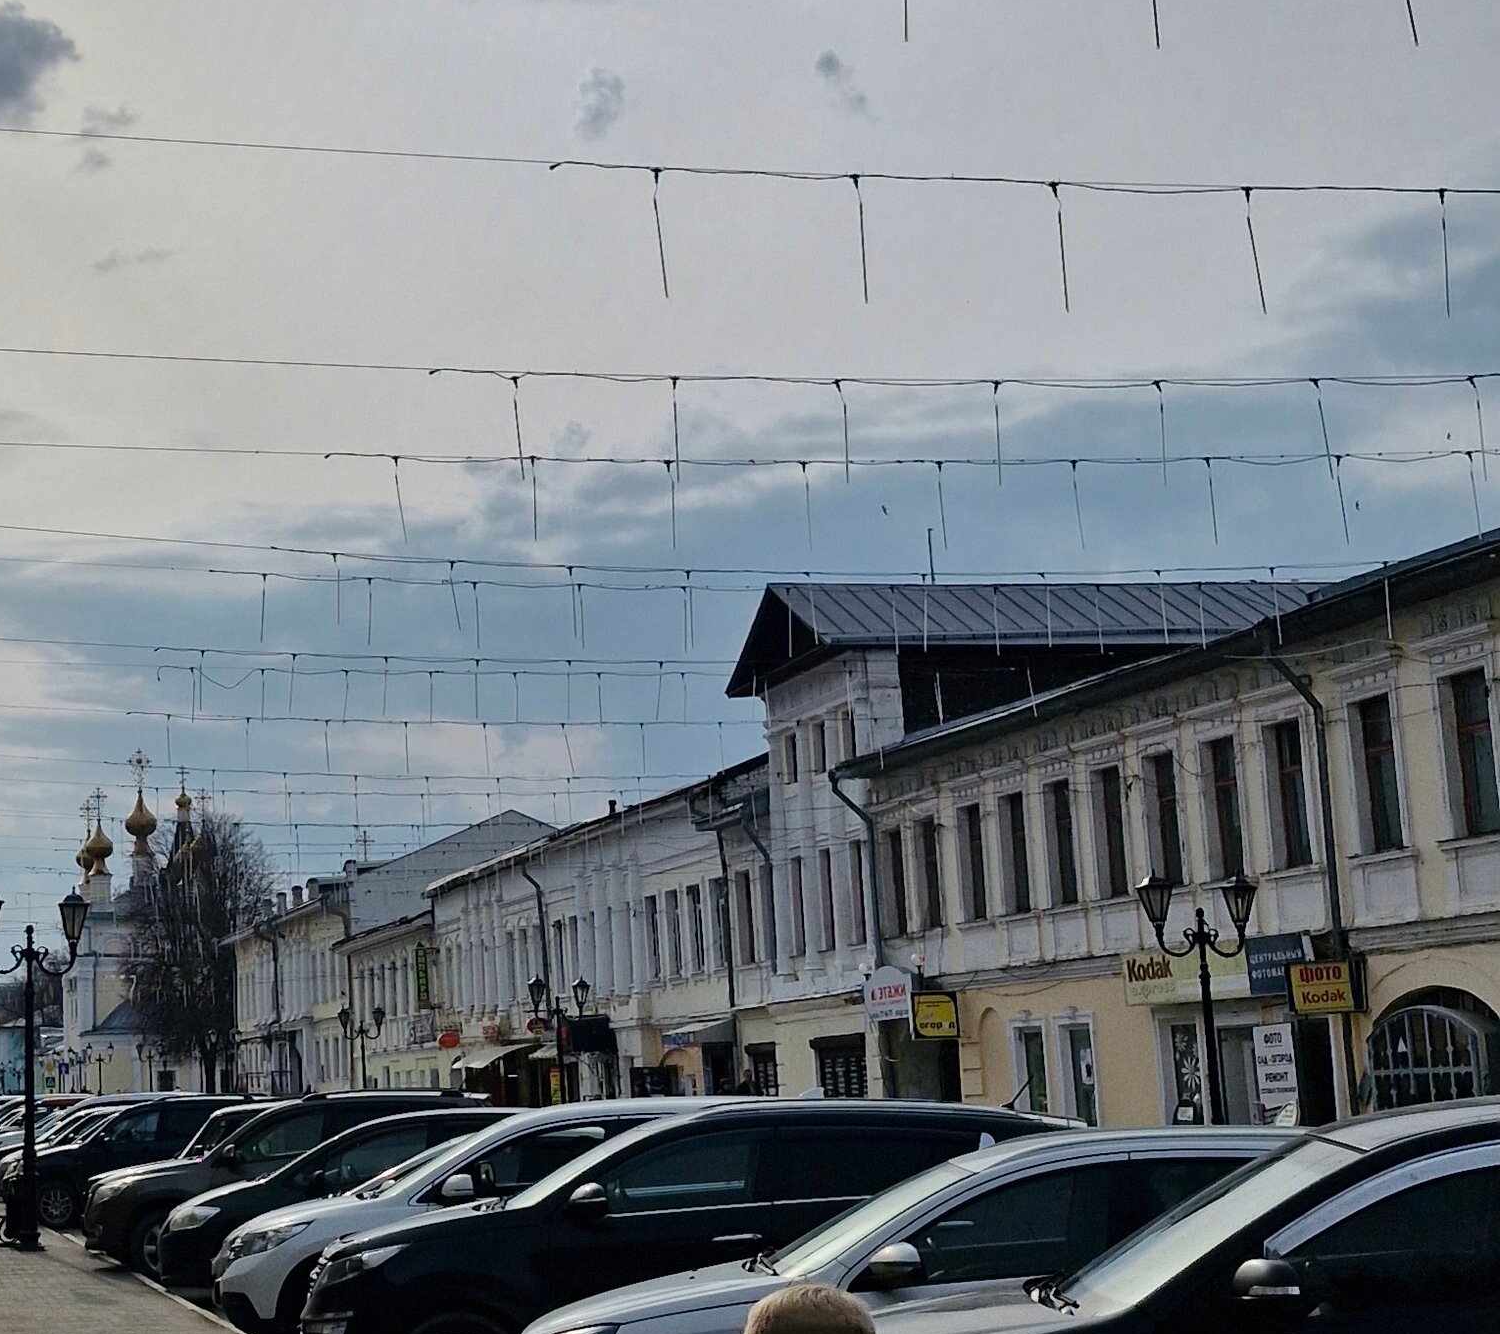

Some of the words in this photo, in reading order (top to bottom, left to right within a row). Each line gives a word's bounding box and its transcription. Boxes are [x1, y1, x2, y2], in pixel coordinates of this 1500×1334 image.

[1249, 948, 1302, 964] ЦЕНТРАЛЬНЫЙ
[1126, 955, 1173, 983] Kodak
[1302, 988, 1346, 1005] Kodak
[1263, 1032, 1282, 1044] ФОТО
[1265, 1071, 1289, 1083] РЕМОНТ
